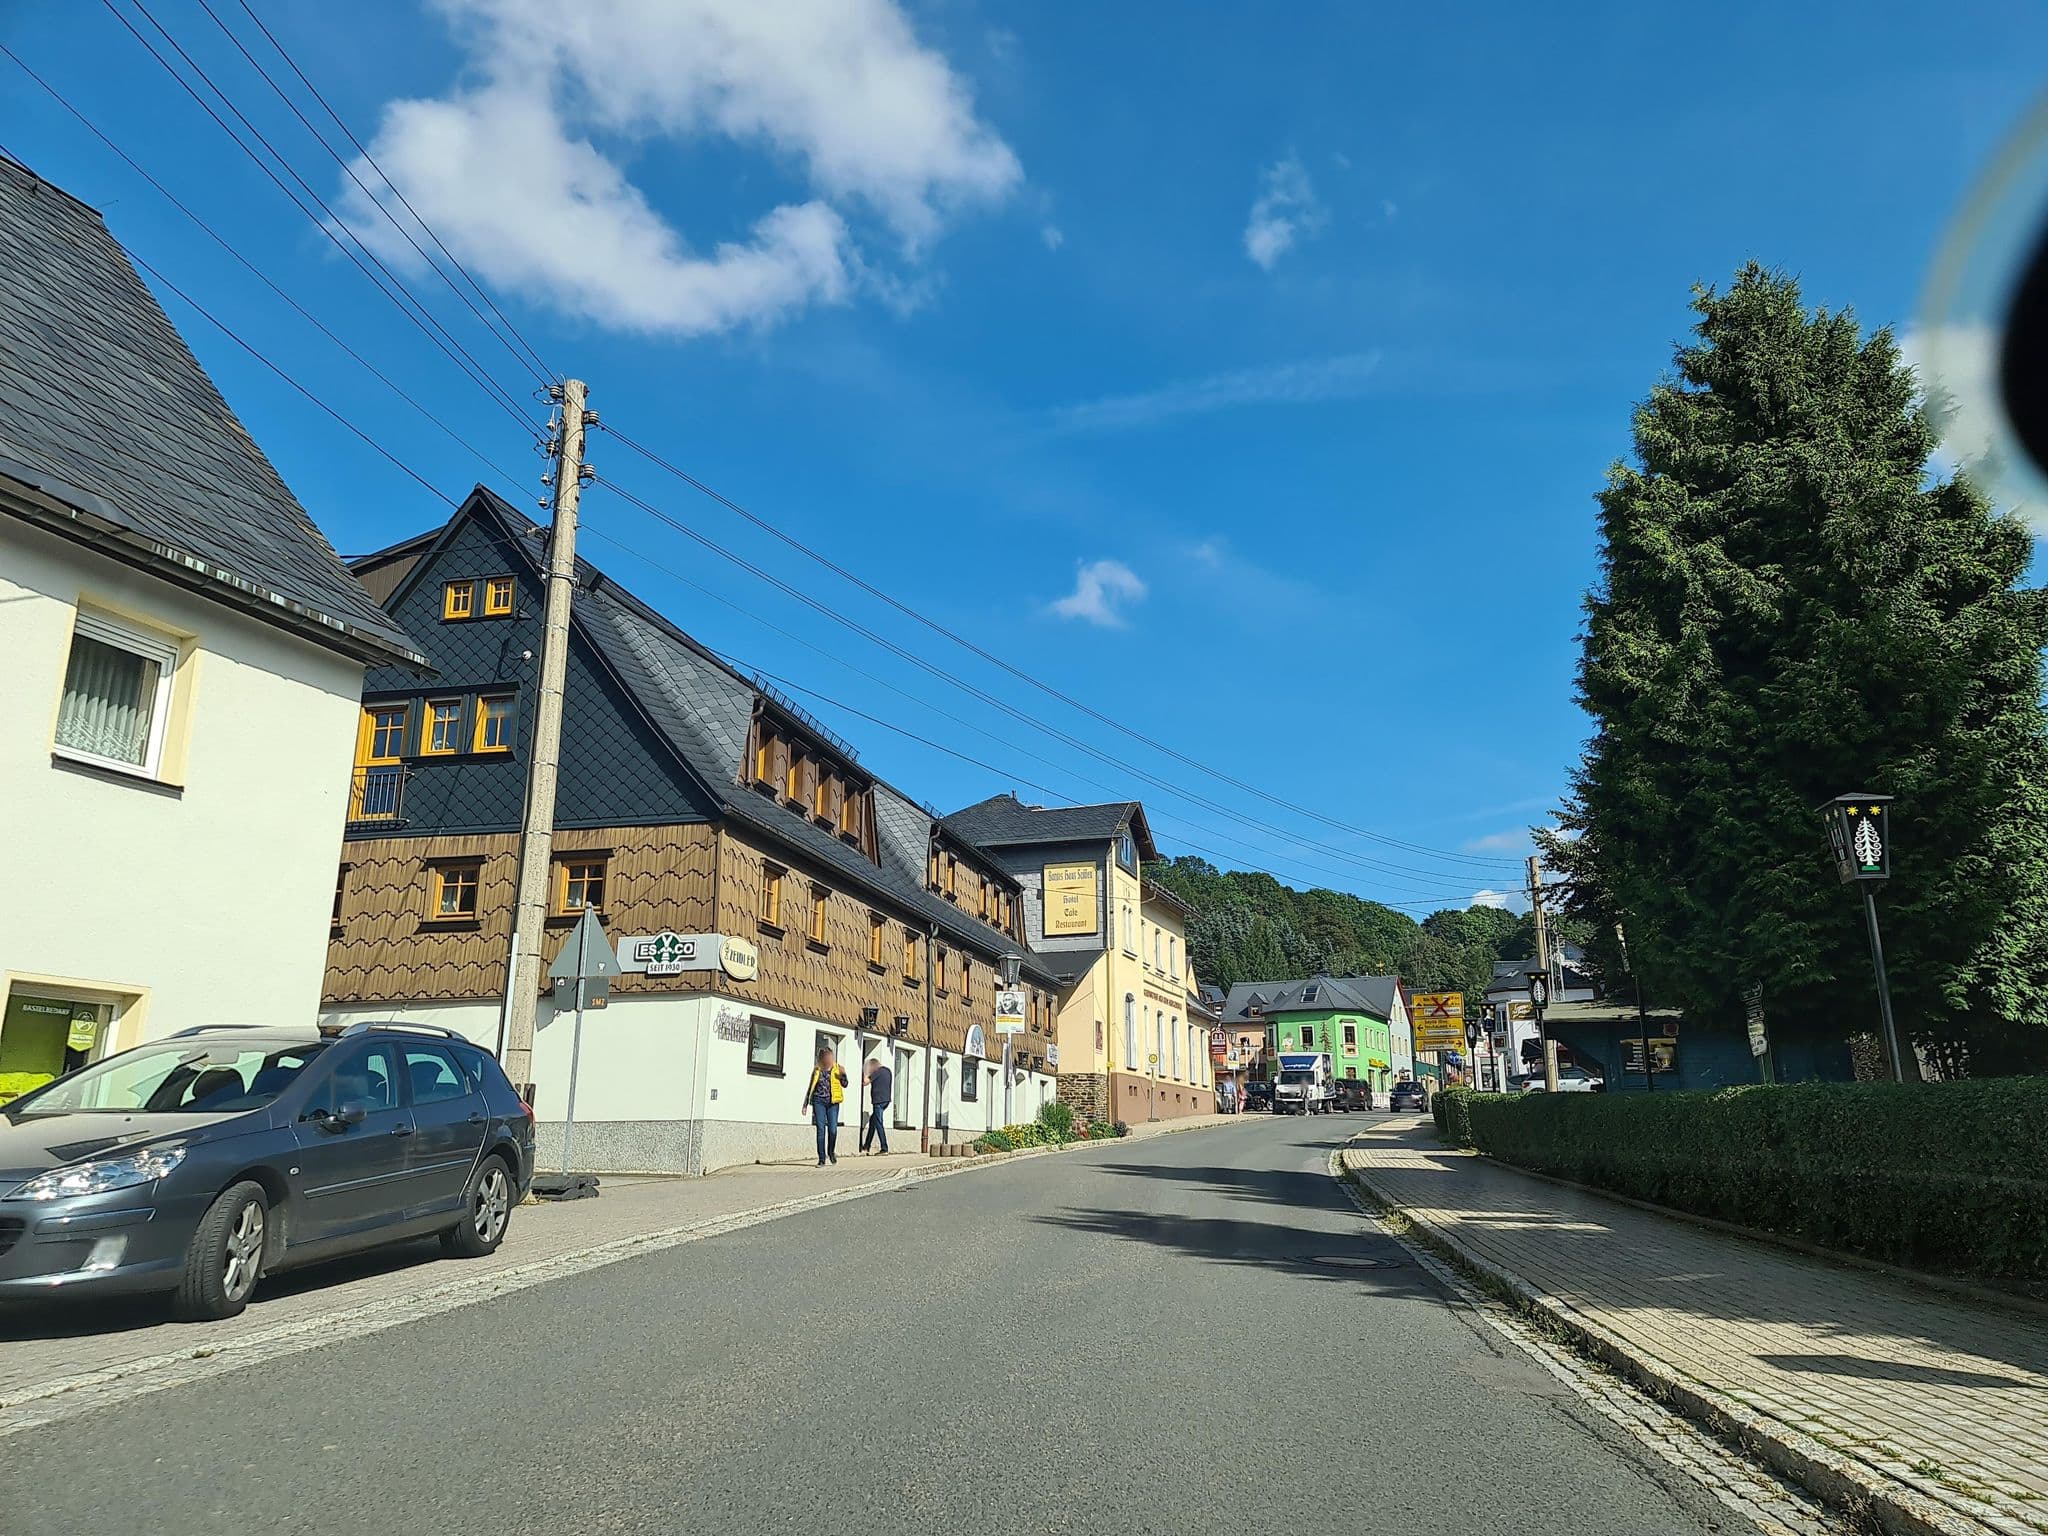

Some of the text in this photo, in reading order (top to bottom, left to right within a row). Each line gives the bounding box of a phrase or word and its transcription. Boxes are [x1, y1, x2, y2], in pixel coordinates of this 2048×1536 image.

[1055, 919, 1087, 929] Restaurant
[730, 949, 756, 968] ZEIDLER
[650, 964, 664, 972] SEIT
